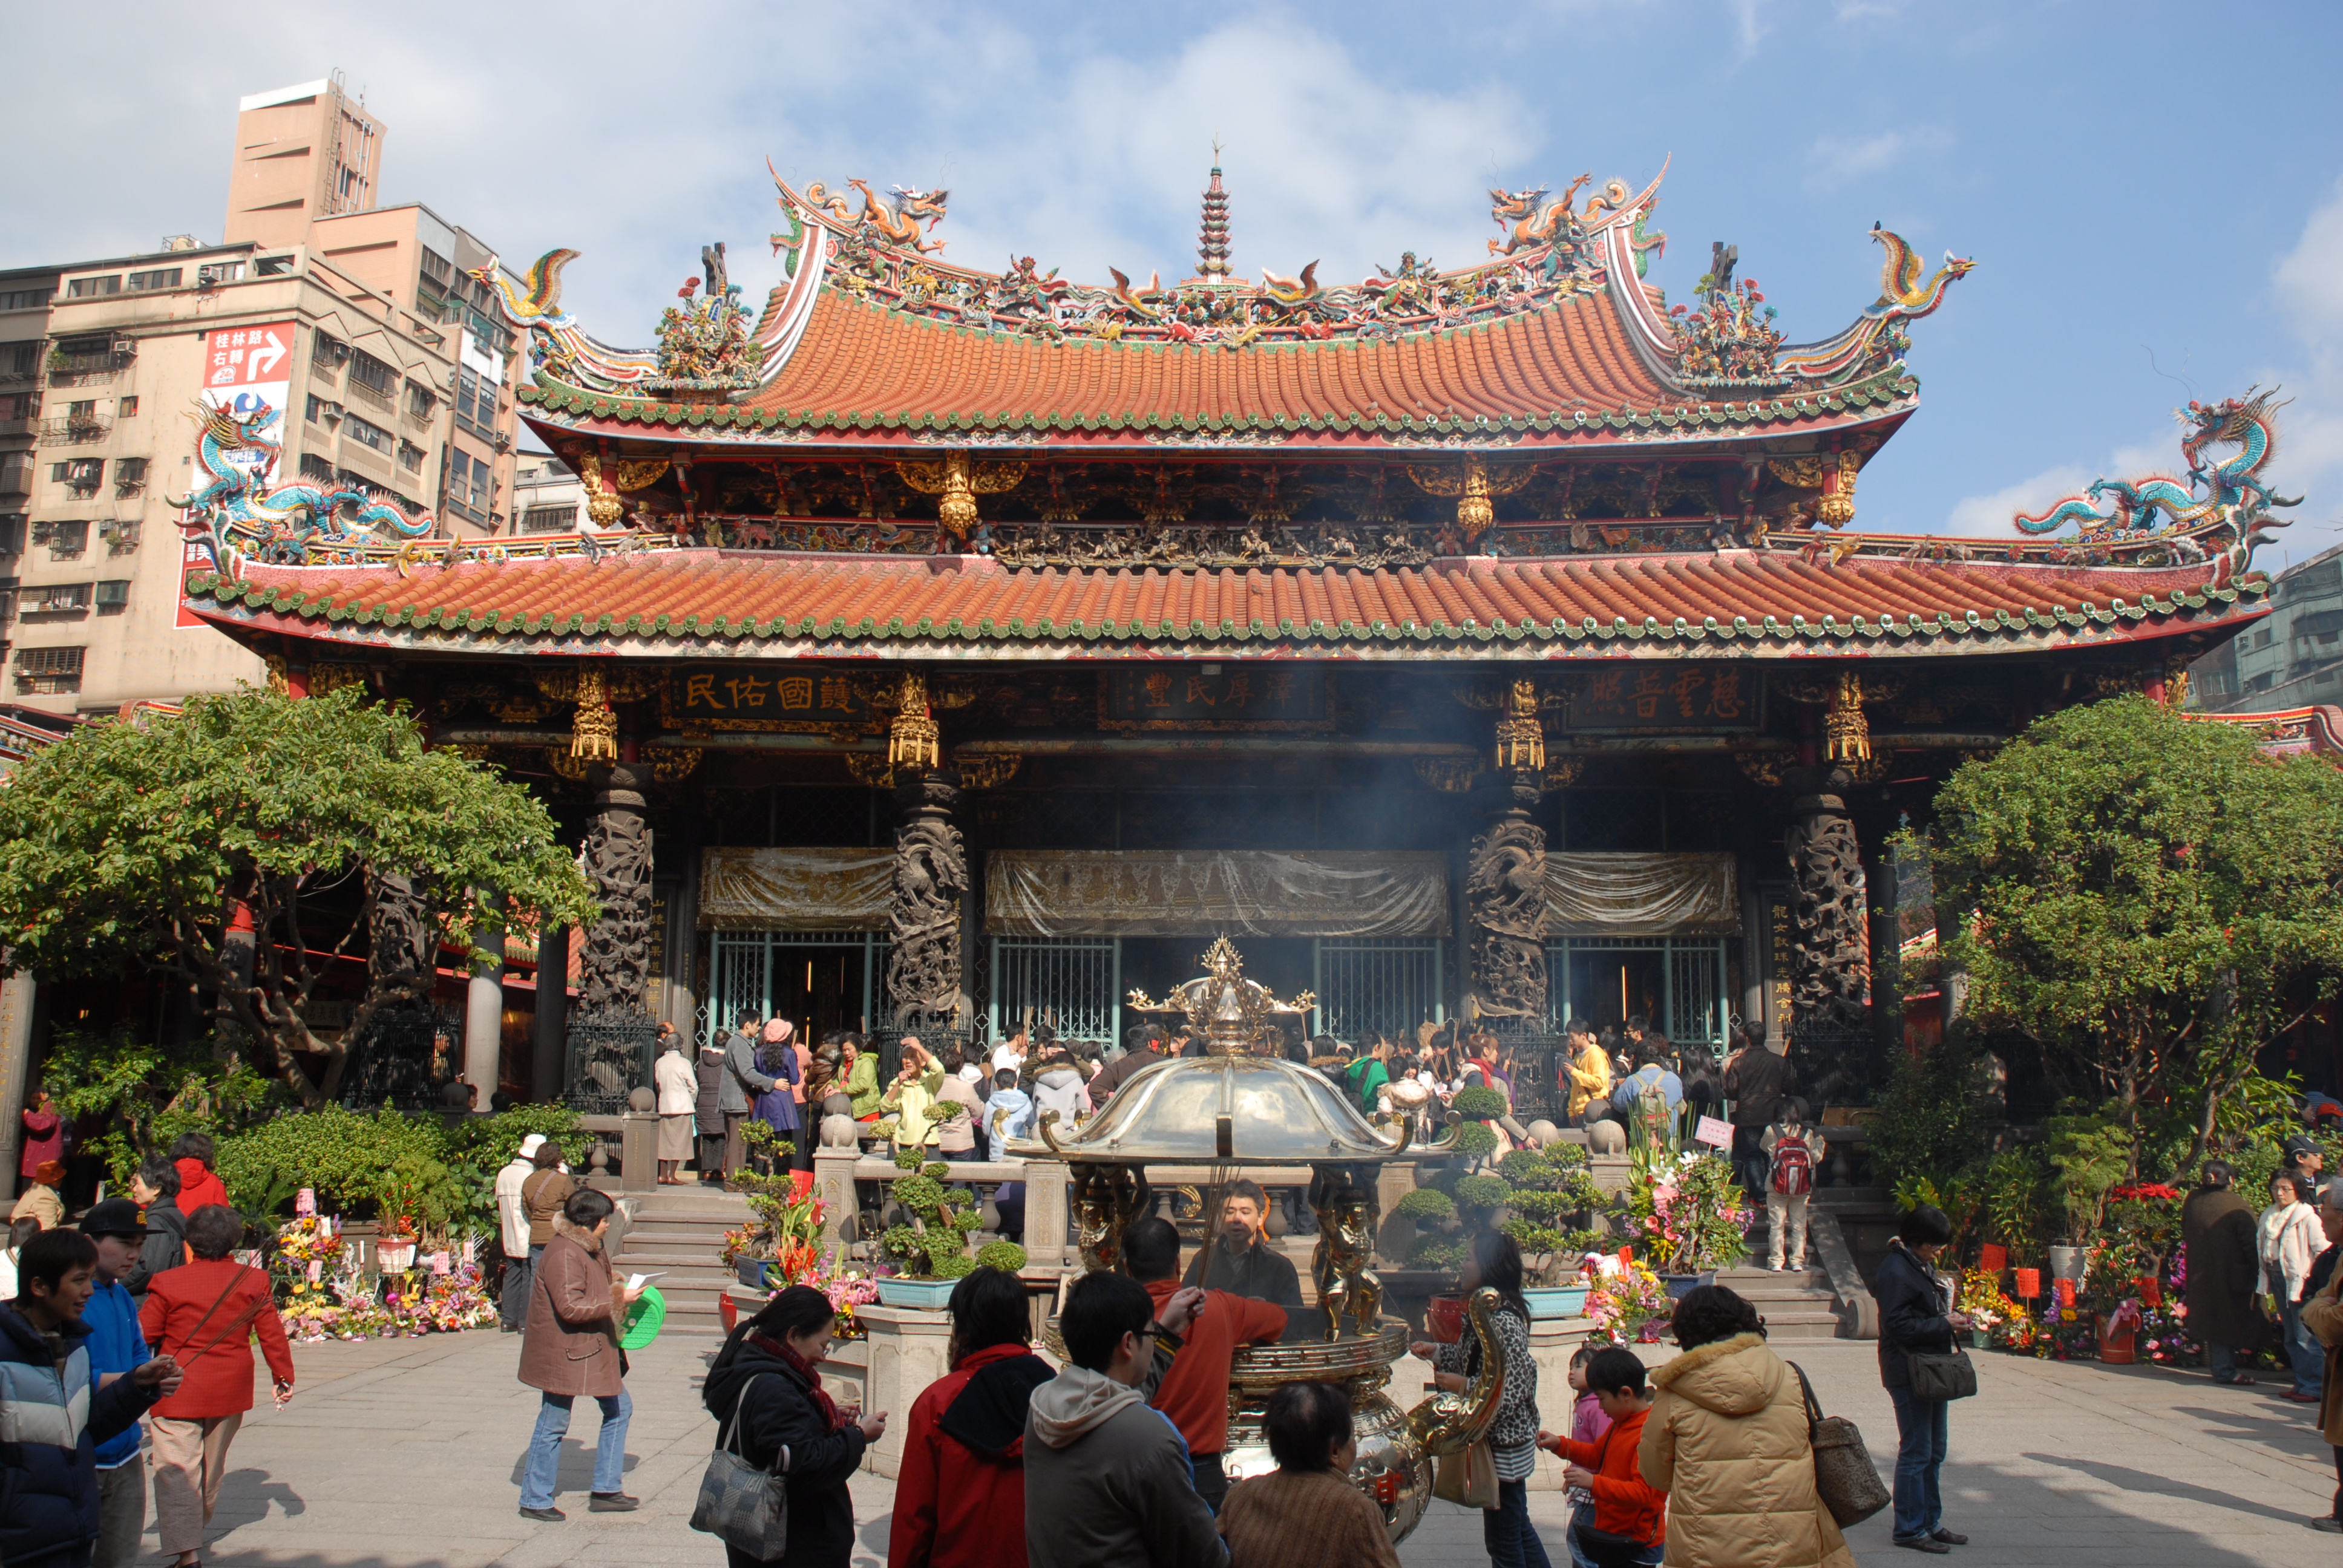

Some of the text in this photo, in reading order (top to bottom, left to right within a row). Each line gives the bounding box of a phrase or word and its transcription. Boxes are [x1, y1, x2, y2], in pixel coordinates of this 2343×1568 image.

[215, 330, 263, 348] 桂林路
[213, 349, 244, 366] 右轉
